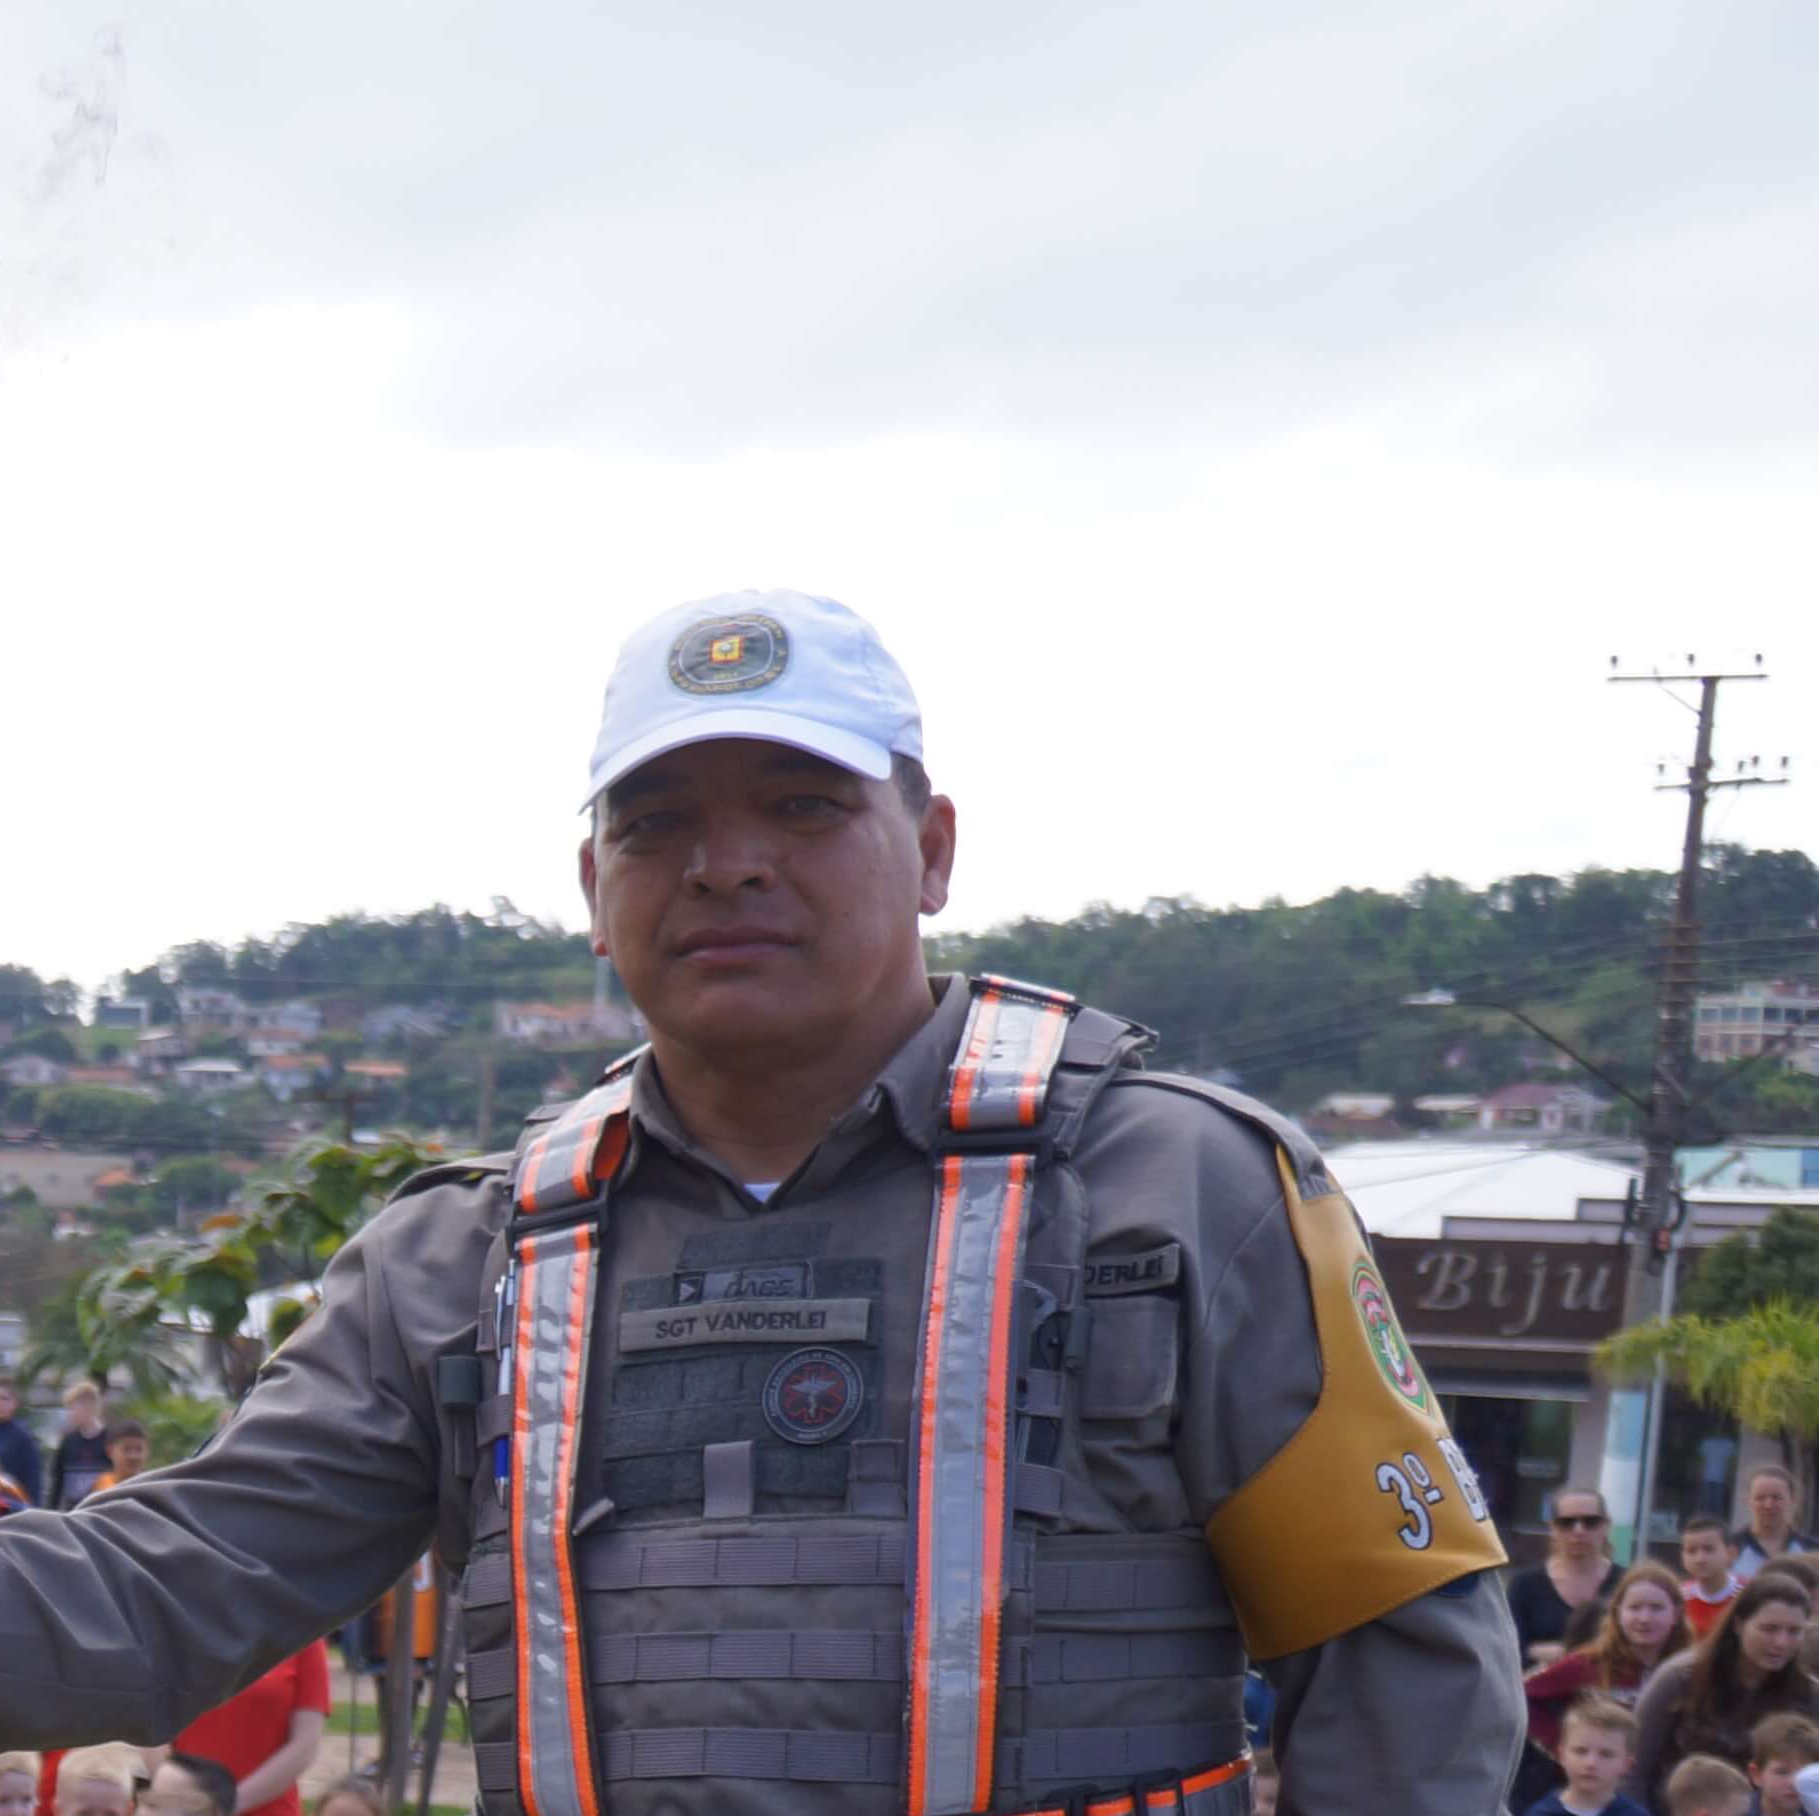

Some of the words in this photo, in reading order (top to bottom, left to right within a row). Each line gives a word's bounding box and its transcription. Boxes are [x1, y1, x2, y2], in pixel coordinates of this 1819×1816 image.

[1416, 1248, 1612, 1336] Biju
[656, 1317, 696, 1339] SGT
[706, 1311, 826, 1332] VANDERLEI
